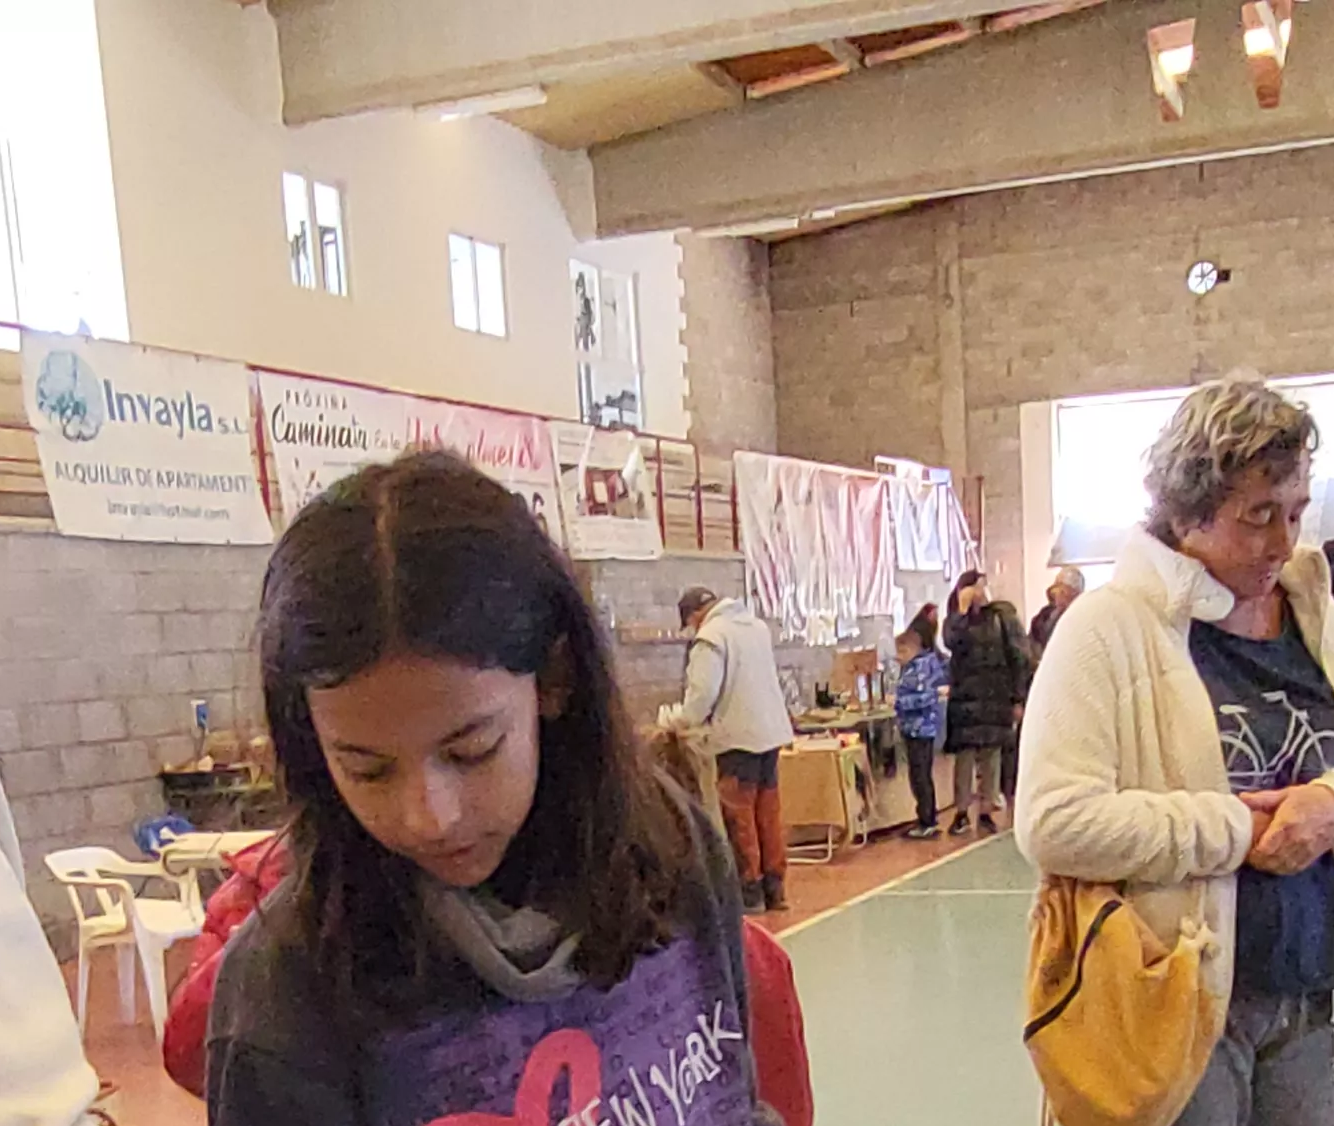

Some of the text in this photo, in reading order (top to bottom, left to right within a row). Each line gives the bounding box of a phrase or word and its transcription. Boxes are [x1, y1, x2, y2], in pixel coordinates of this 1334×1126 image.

[103, 377, 213, 440] Invayla
[55, 461, 134, 486] ALQUILER
[650, 1000, 744, 1126] YORK
